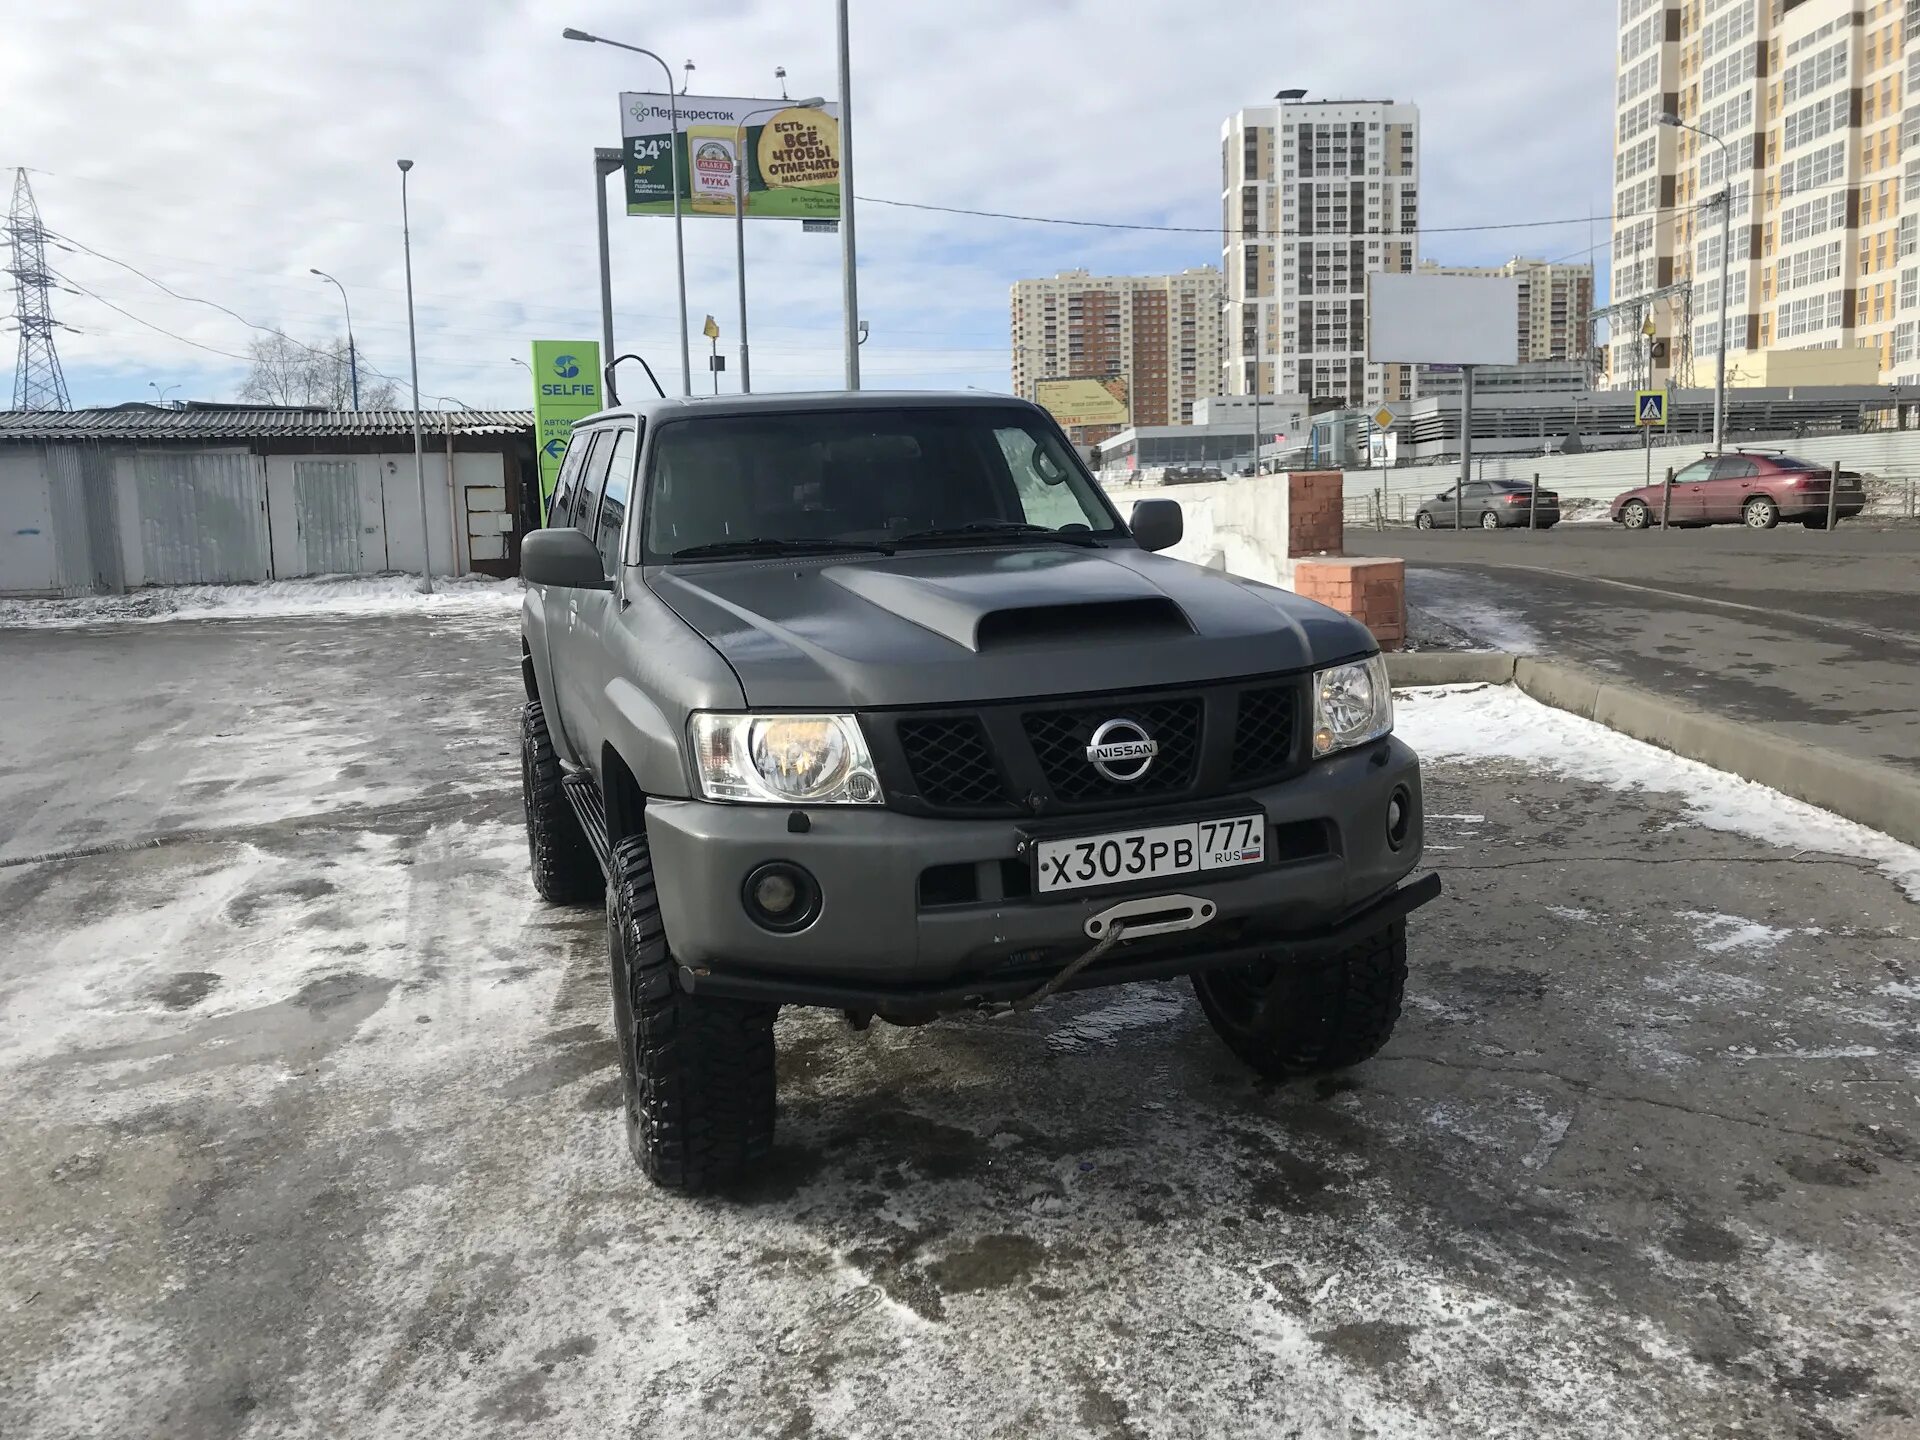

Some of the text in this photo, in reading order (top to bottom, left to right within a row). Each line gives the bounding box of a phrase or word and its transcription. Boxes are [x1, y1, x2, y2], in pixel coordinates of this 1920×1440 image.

[774, 121, 804, 133] ЕСТЬ
[784, 126, 823, 148] ВСЁ,
[772, 146, 831, 162] ЧТОБЫ
[768, 158, 839, 175] ОТМЕЧАТЬ
[702, 177, 730, 187] МУКА
[781, 171, 838, 183] МАСЛЕНИЦУ
[542, 384, 595, 396] SELFIE
[1096, 743, 1153, 758] NISSAN
[1200, 819, 1253, 853] 777
[1214, 850, 1241, 864] RUS
